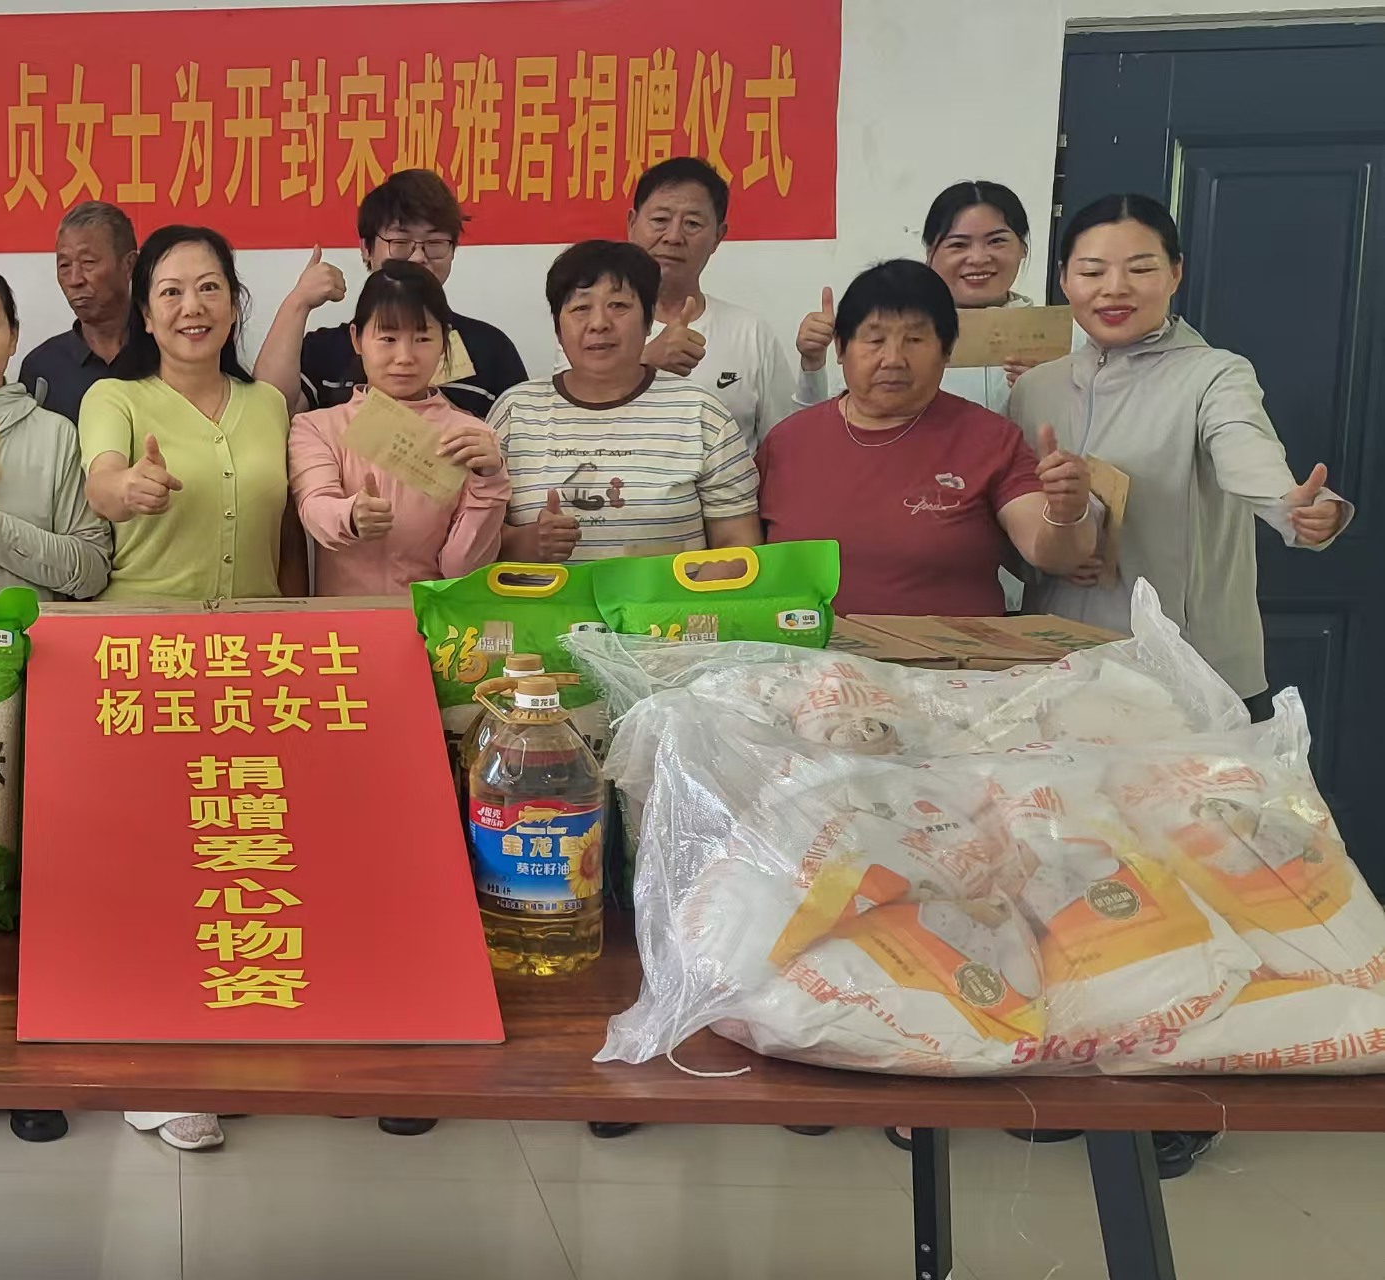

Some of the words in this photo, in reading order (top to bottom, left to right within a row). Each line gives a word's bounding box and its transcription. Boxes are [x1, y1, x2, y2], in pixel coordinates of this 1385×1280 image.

[95, 632, 360, 680] 何敏坚女士
[96, 685, 369, 736] 杨玉贞女士
[187, 756, 311, 1009] 捐赠爱心物资
[516, 862, 570, 876] 葵花籽油
